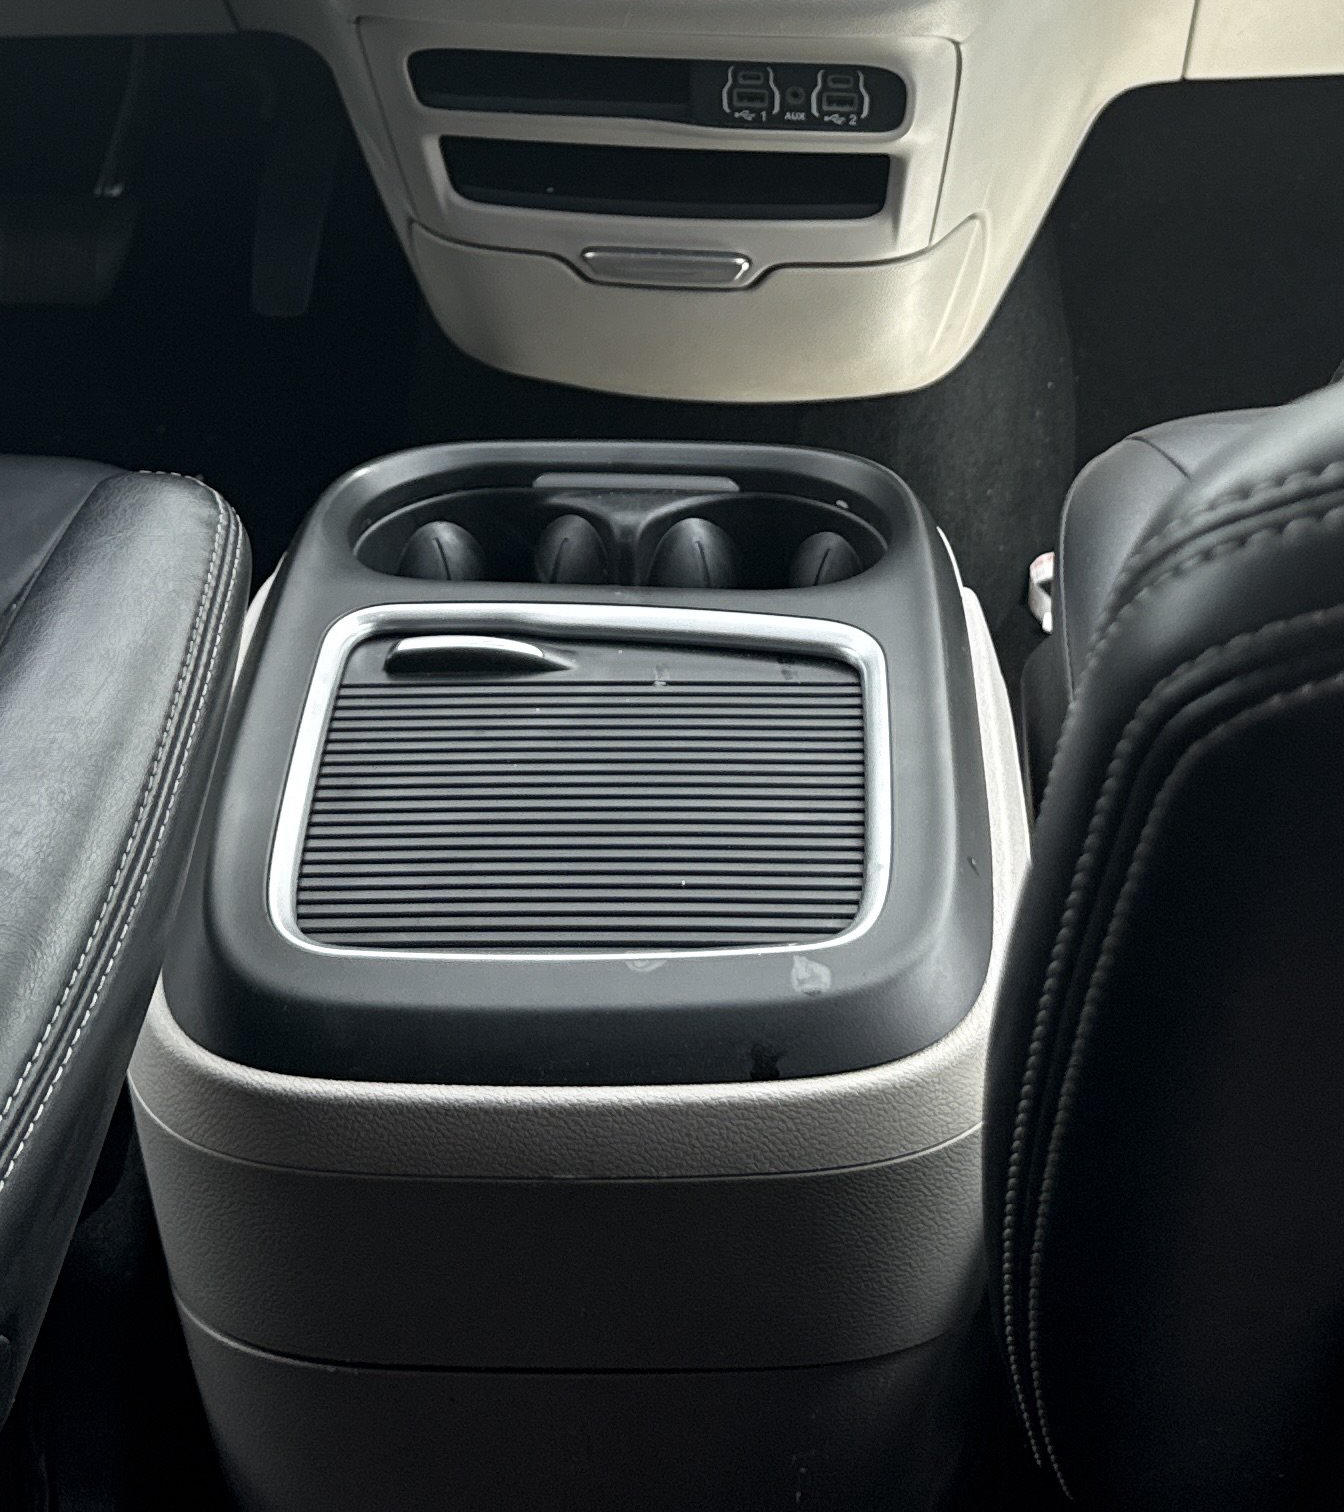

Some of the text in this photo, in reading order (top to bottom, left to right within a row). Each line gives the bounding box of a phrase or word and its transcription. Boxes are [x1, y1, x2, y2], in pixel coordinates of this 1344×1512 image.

[760, 110, 767, 122] 1
[784, 111, 806, 121] AUX
[848, 113, 857, 126] 2
